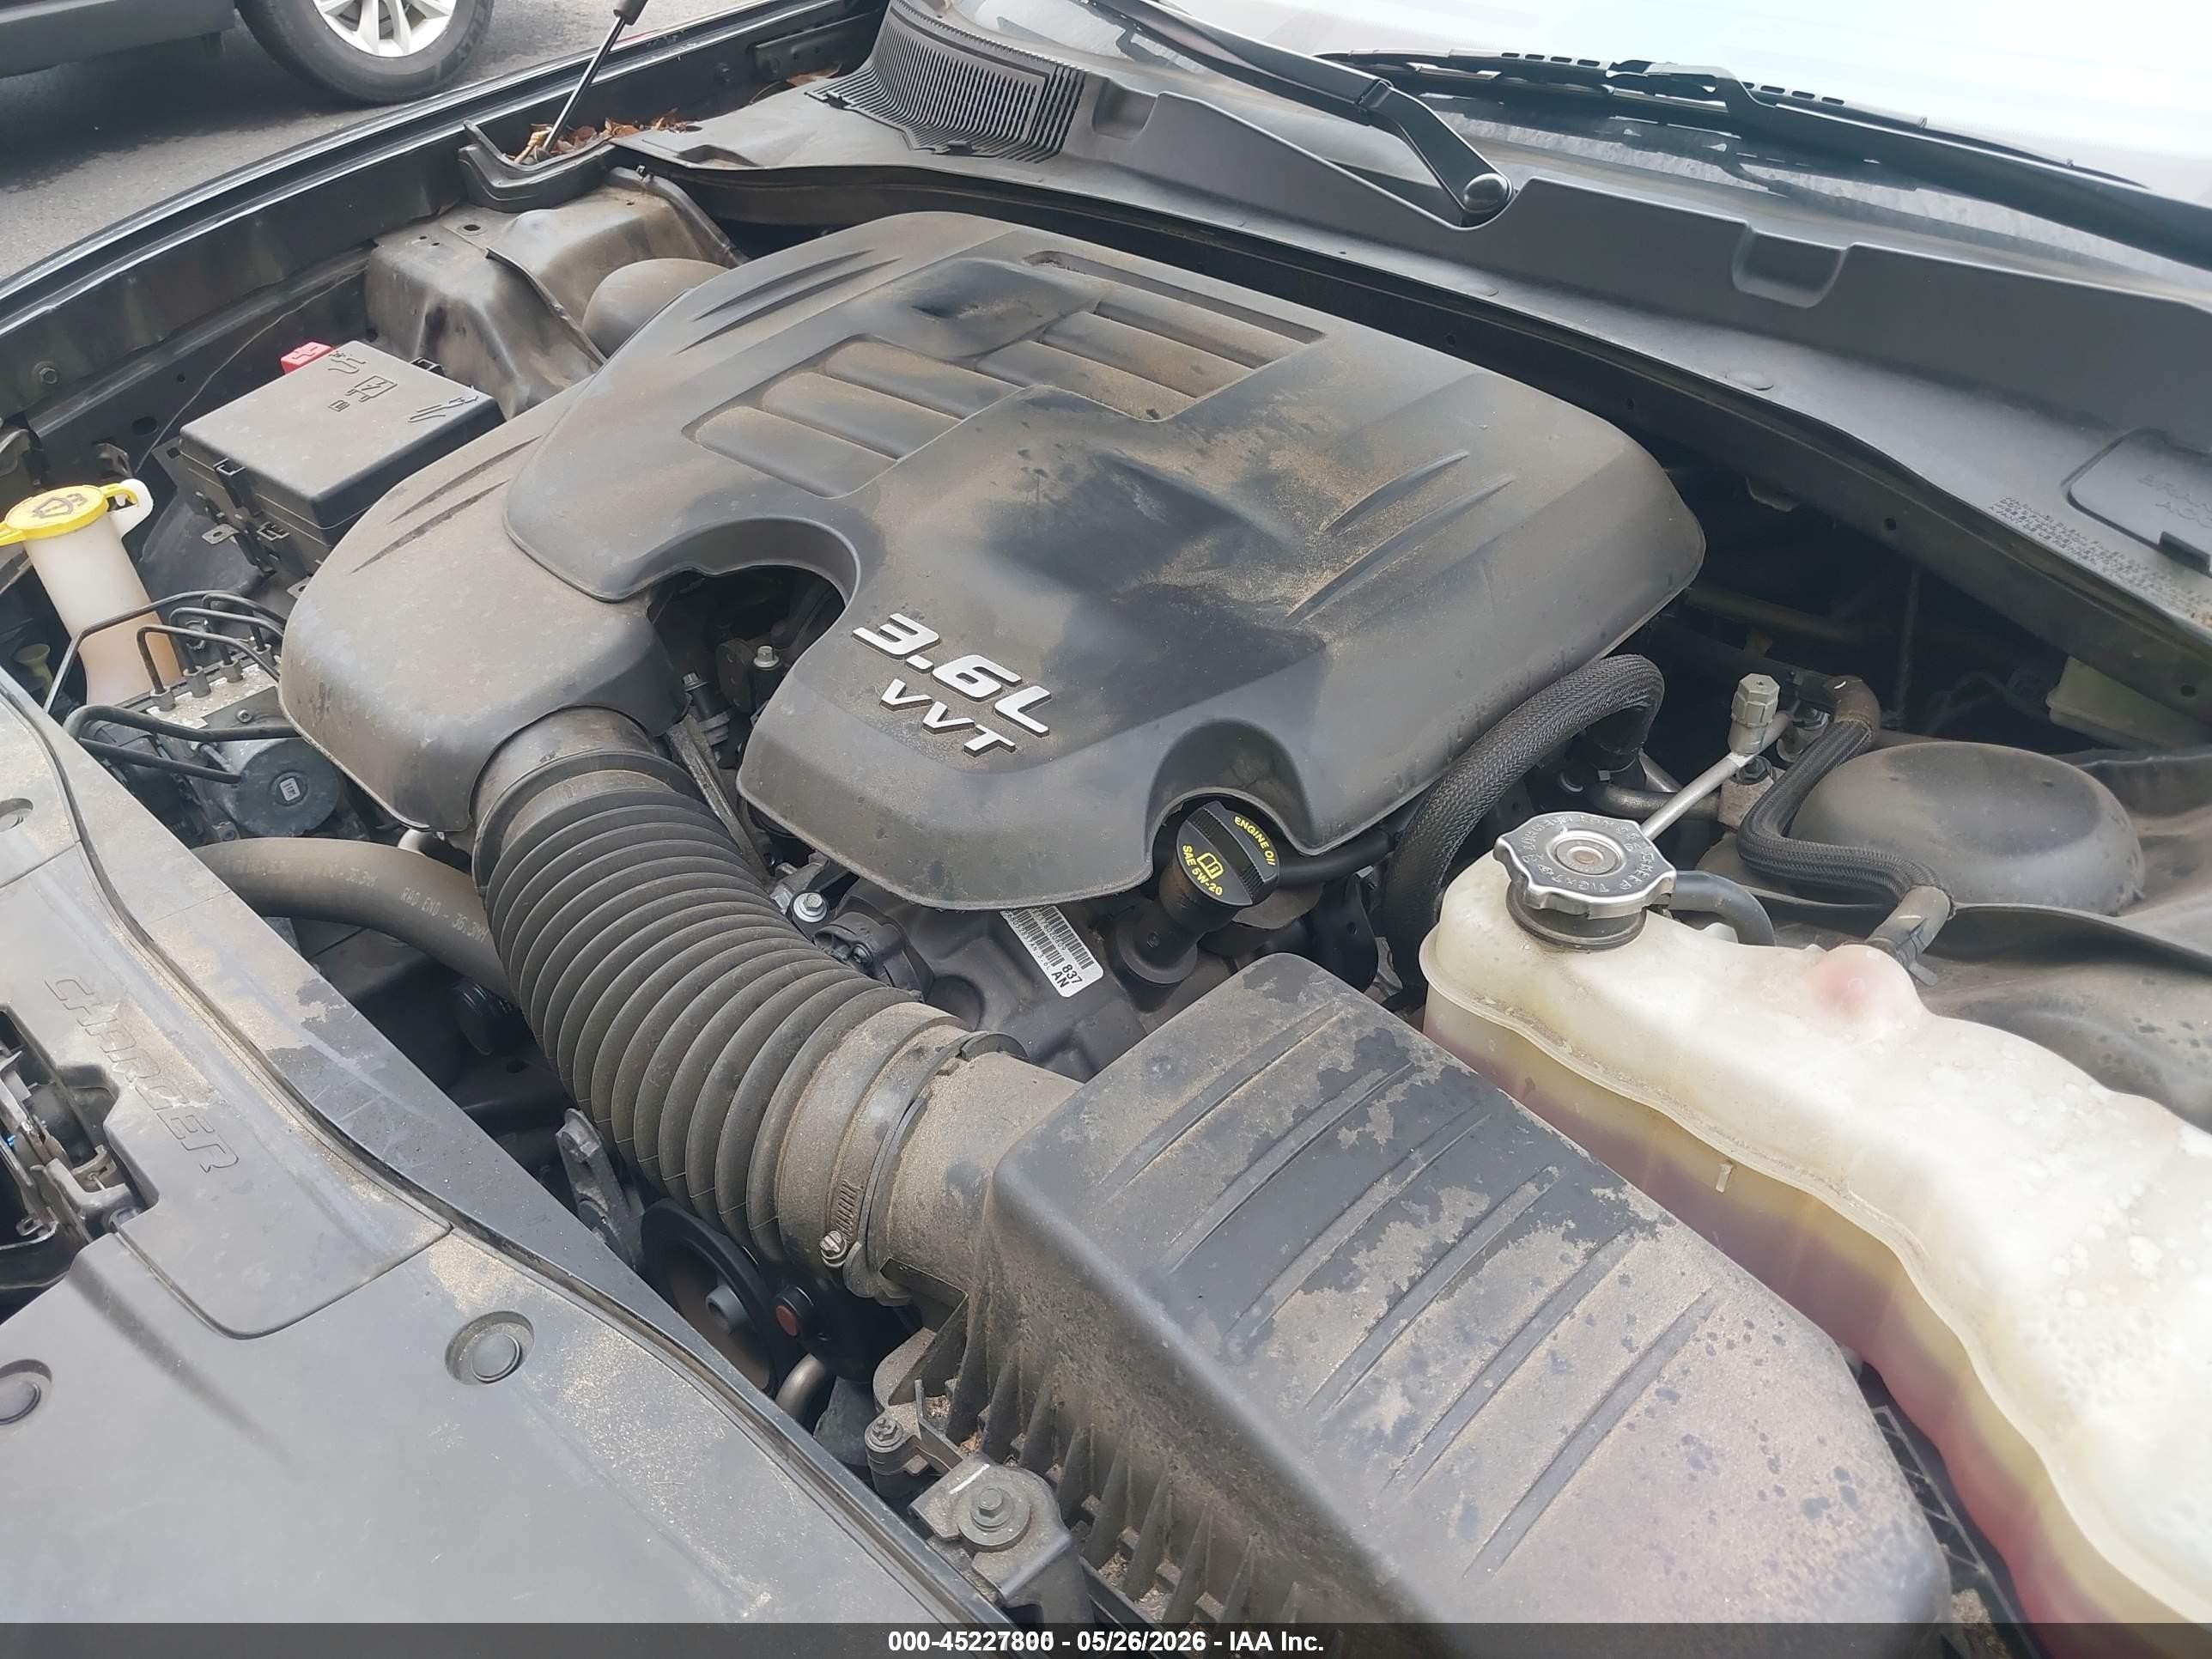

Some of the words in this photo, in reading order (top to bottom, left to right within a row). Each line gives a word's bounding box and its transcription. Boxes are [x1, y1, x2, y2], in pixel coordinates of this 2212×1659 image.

[851, 613, 1052, 738] 3.6L
[879, 678, 1017, 758] VVT
[1234, 816, 1270, 849] ENGINE
[1182, 845, 1197, 866] SAE
[1191, 866, 1223, 896] 5W-20
[1051, 970, 1071, 988] AN
[1062, 963, 1084, 985] 837
[45, 975, 240, 1174] CHARGER
